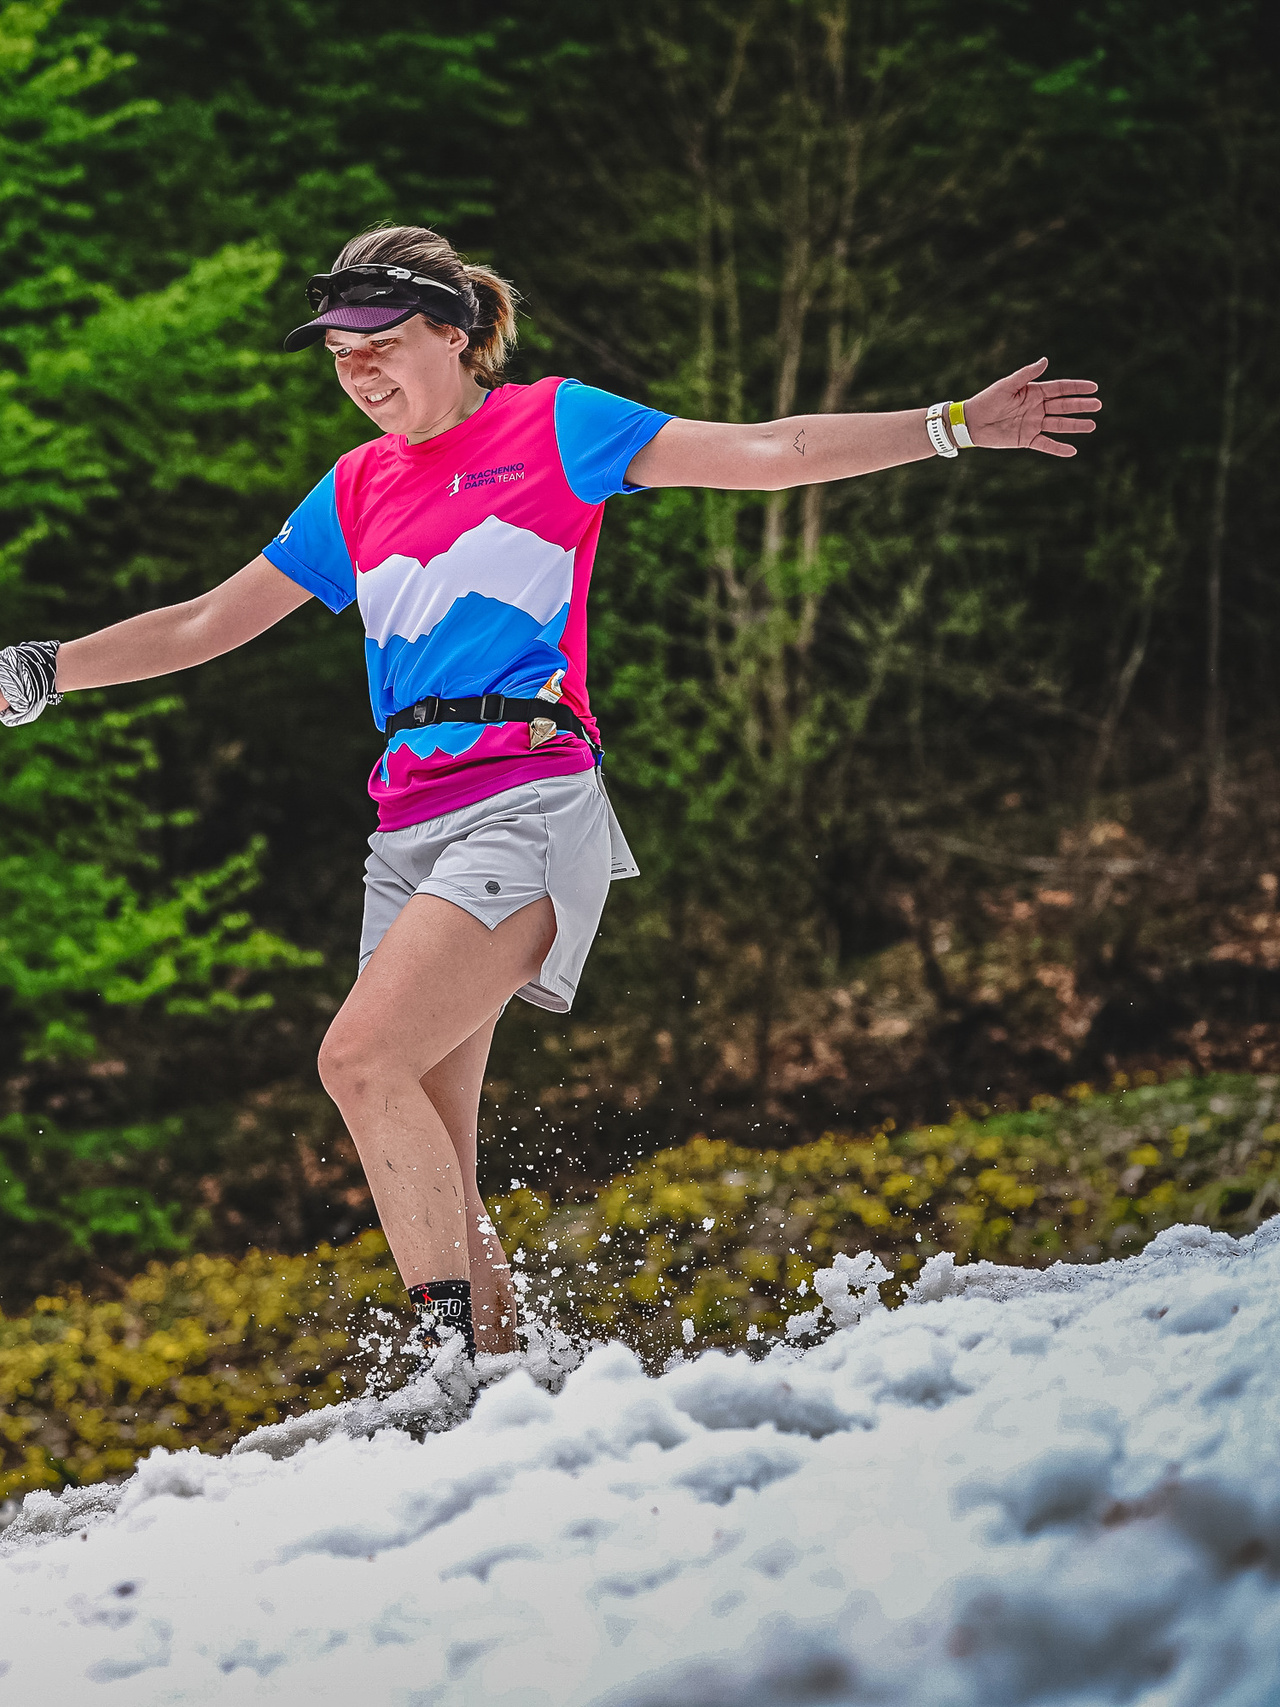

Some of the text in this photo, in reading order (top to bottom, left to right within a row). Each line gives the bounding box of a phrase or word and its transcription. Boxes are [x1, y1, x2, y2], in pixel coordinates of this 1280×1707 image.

[464, 471, 525, 490] DARYA TEAM
[466, 462, 525, 481] TKACHENKO
